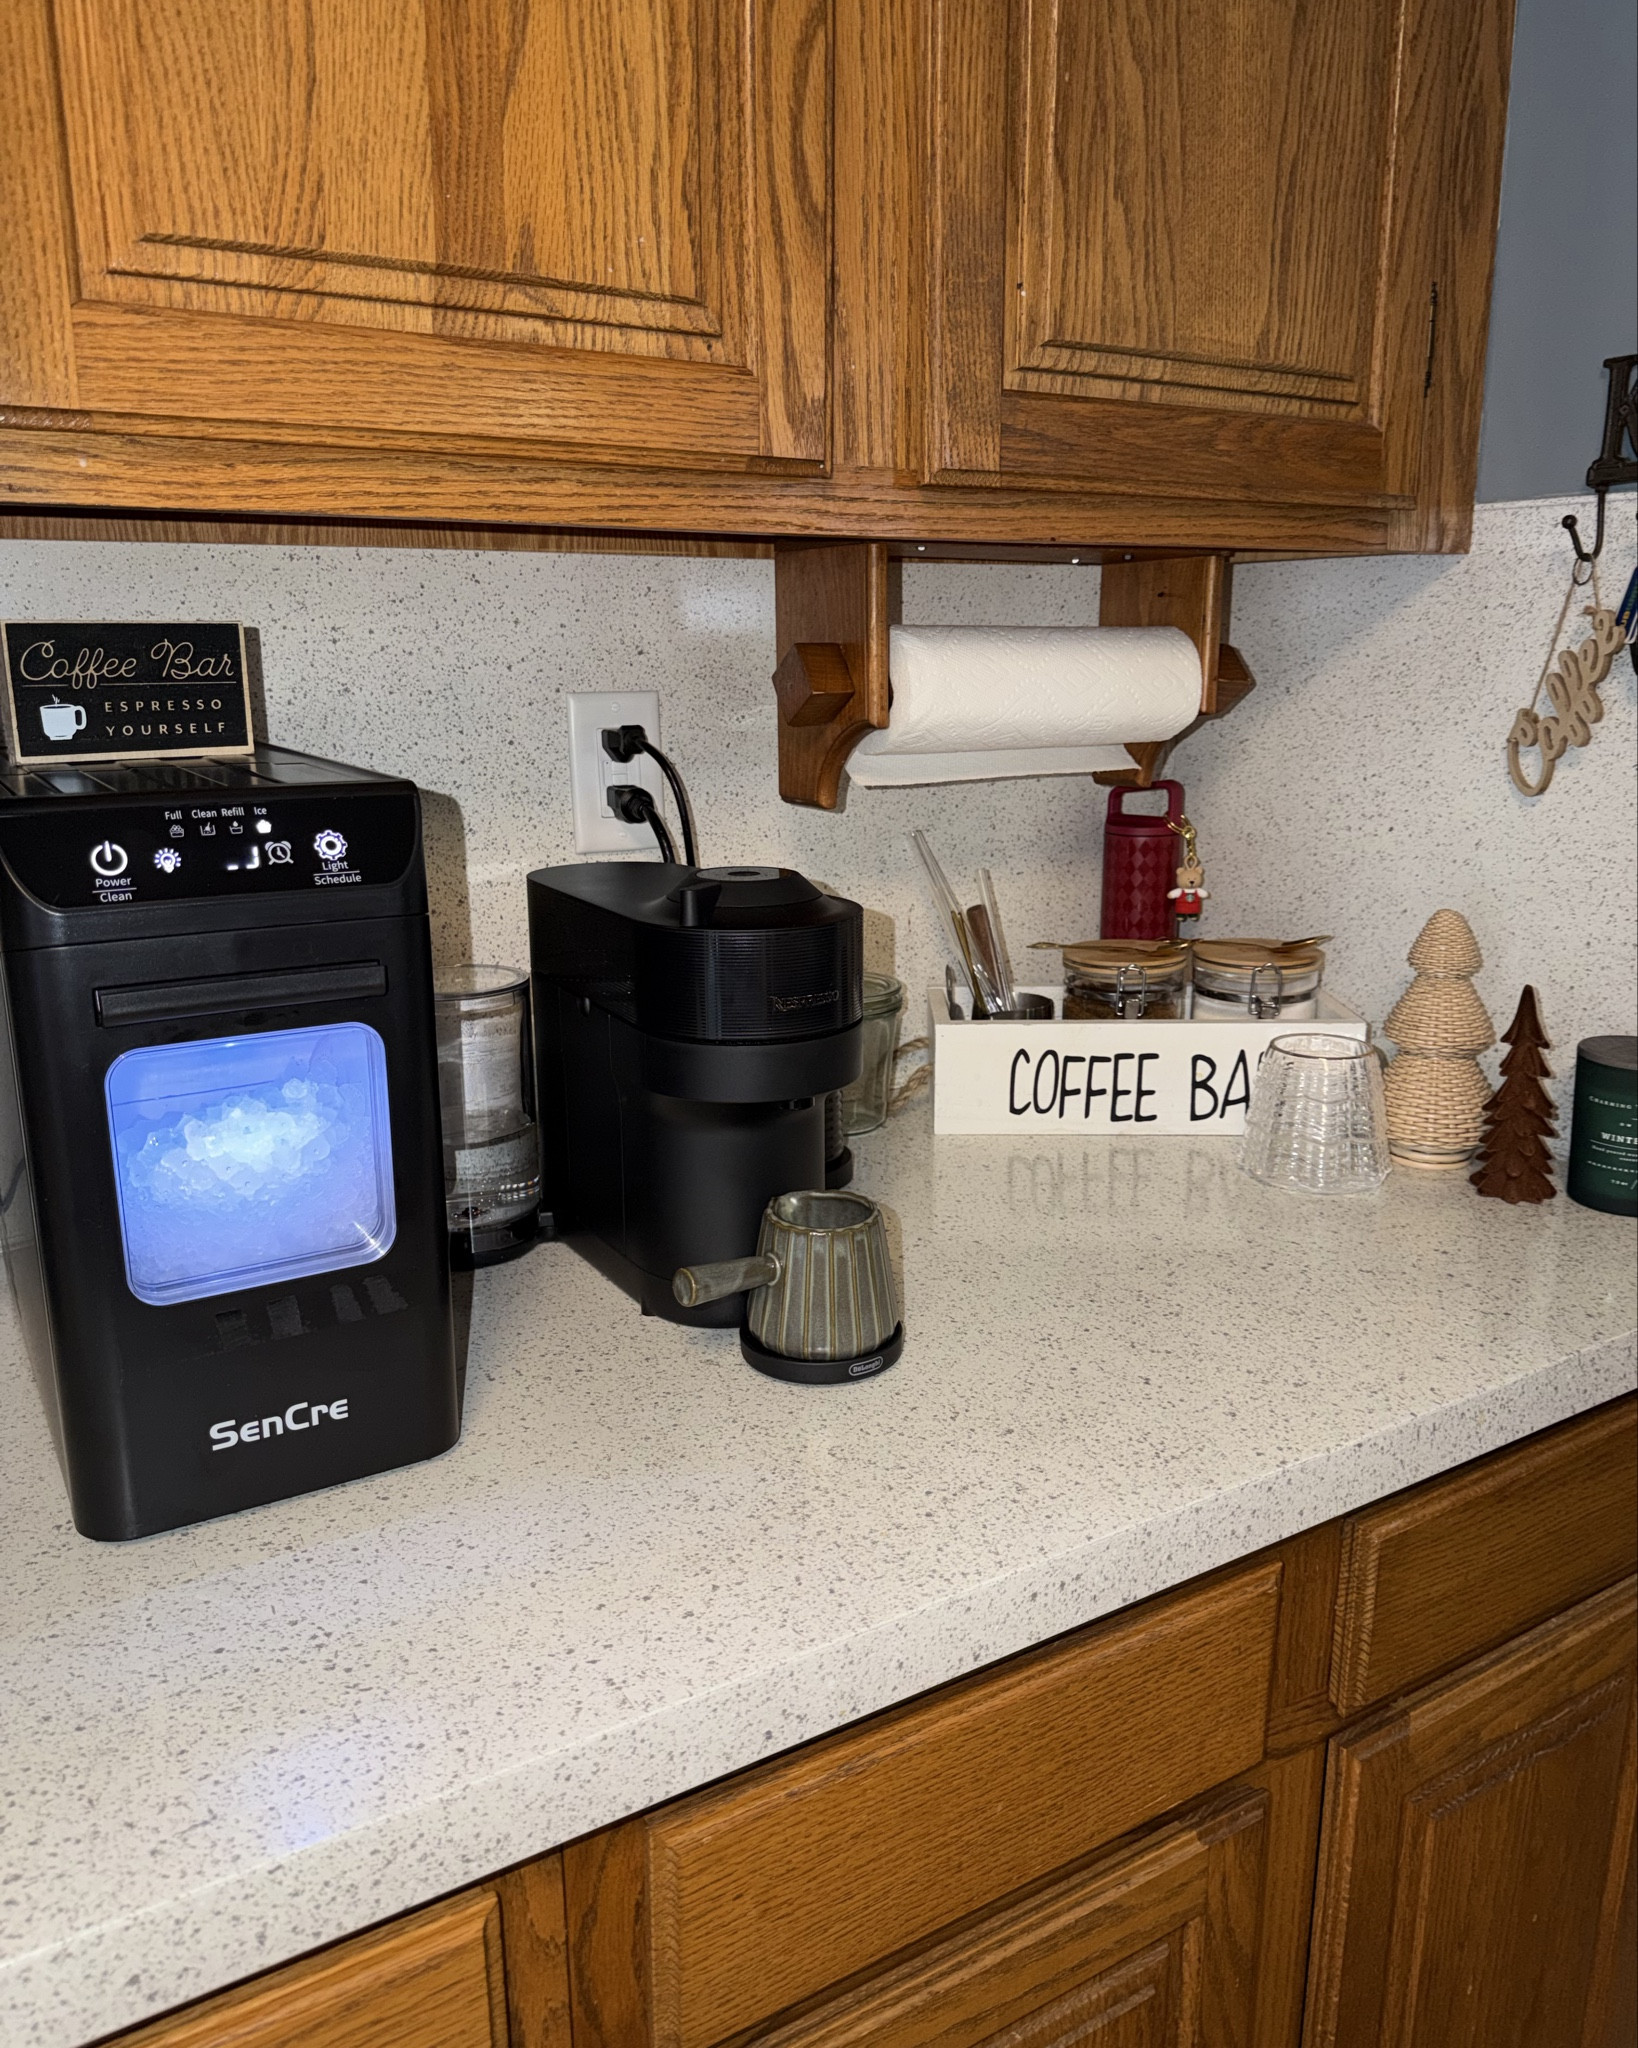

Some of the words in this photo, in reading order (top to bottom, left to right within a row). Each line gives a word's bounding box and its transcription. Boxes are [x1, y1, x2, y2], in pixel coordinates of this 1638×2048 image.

[20, 639, 137, 690] Coffee
[150, 638, 234, 680] Bar
[104, 699, 222, 713] ESPRESSO
[105, 722, 226, 737] YOURSELF
[165, 810, 183, 820] Full
[191, 808, 217, 818] Clean
[221, 807, 245, 817] Refill
[253, 806, 267, 815] Ice
[321, 860, 349, 872] Light
[95, 876, 132, 888] Power
[314, 873, 362, 885] Schedule
[100, 891, 133, 903] Clean
[1009, 1048, 1160, 1123] COFFEE
[1190, 1049, 1264, 1122] BA
[209, 1398, 349, 1451] SenCre
